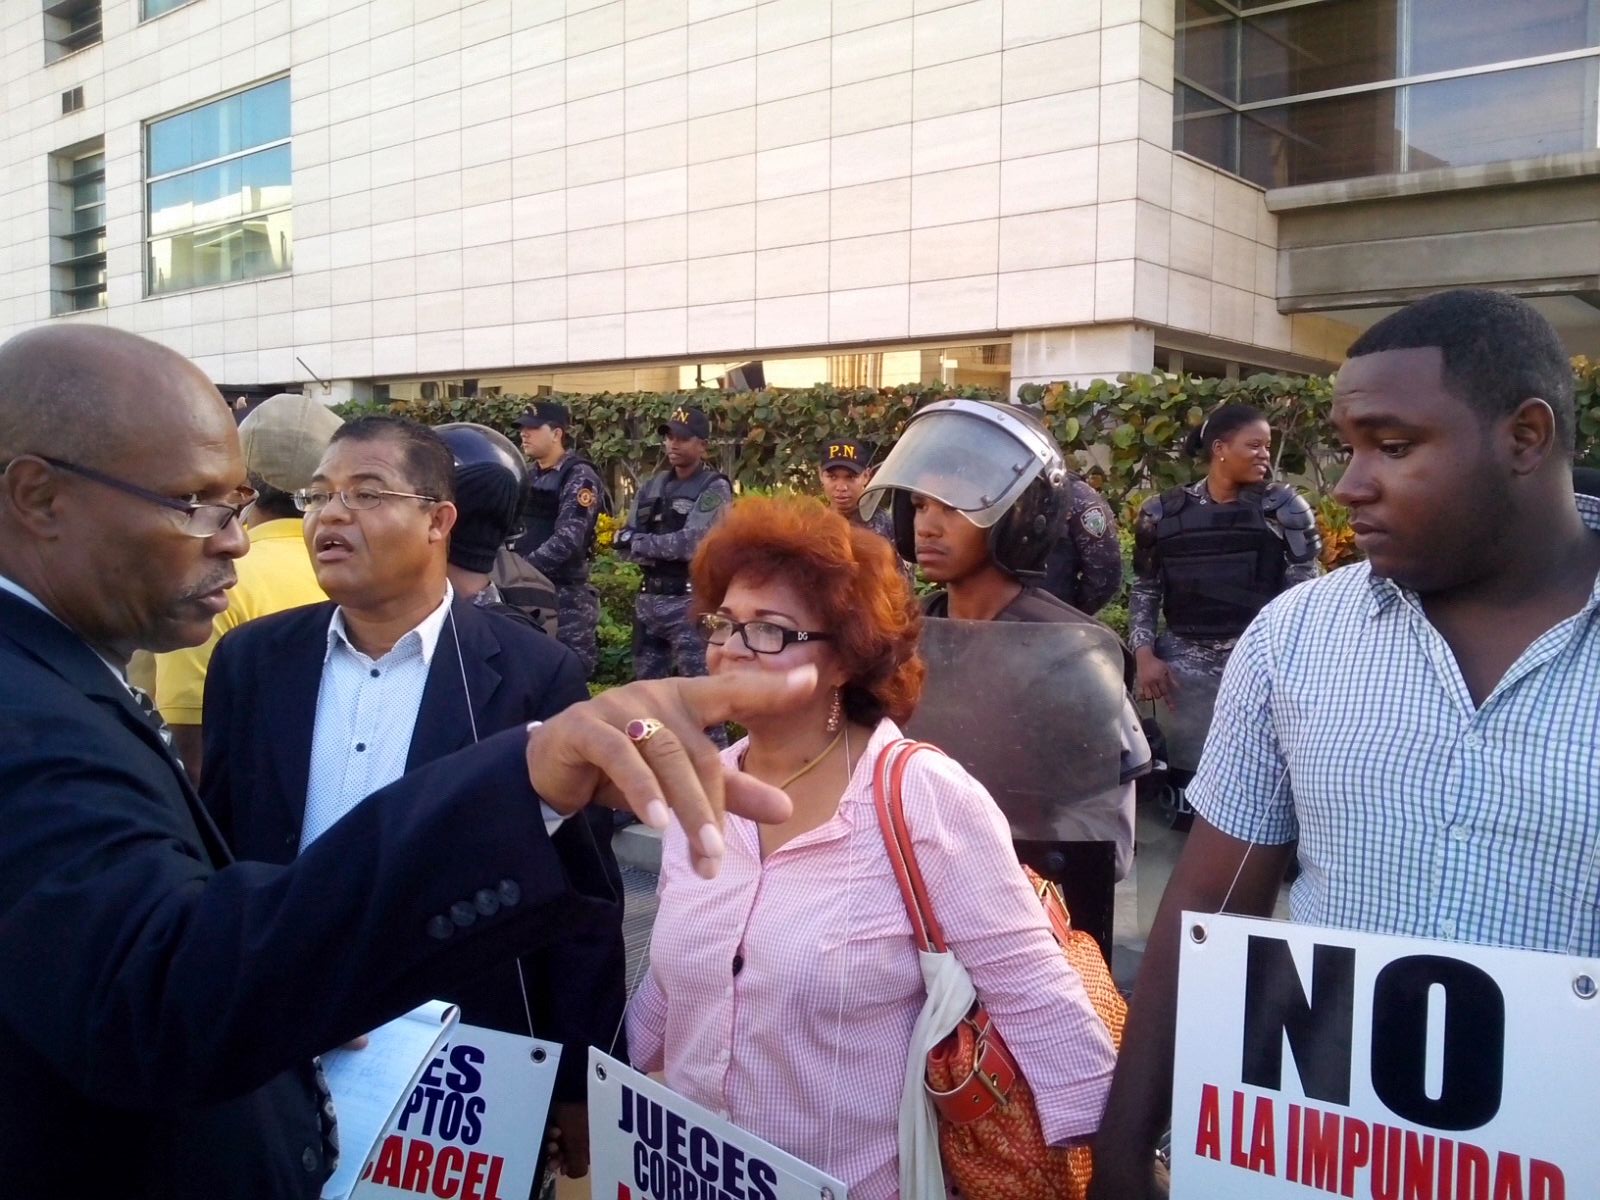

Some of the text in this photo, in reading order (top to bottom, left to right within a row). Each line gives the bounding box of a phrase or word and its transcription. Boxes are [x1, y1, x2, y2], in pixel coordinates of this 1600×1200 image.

[828, 444, 858, 460] P.N.
[797, 631, 809, 641] DG
[1241, 934, 1506, 1132] NO
[361, 1134, 504, 1200] ARCEL
[618, 1084, 778, 1200] JUECES
[1195, 1083, 1221, 1161] A
[1230, 1090, 1276, 1177] LA
